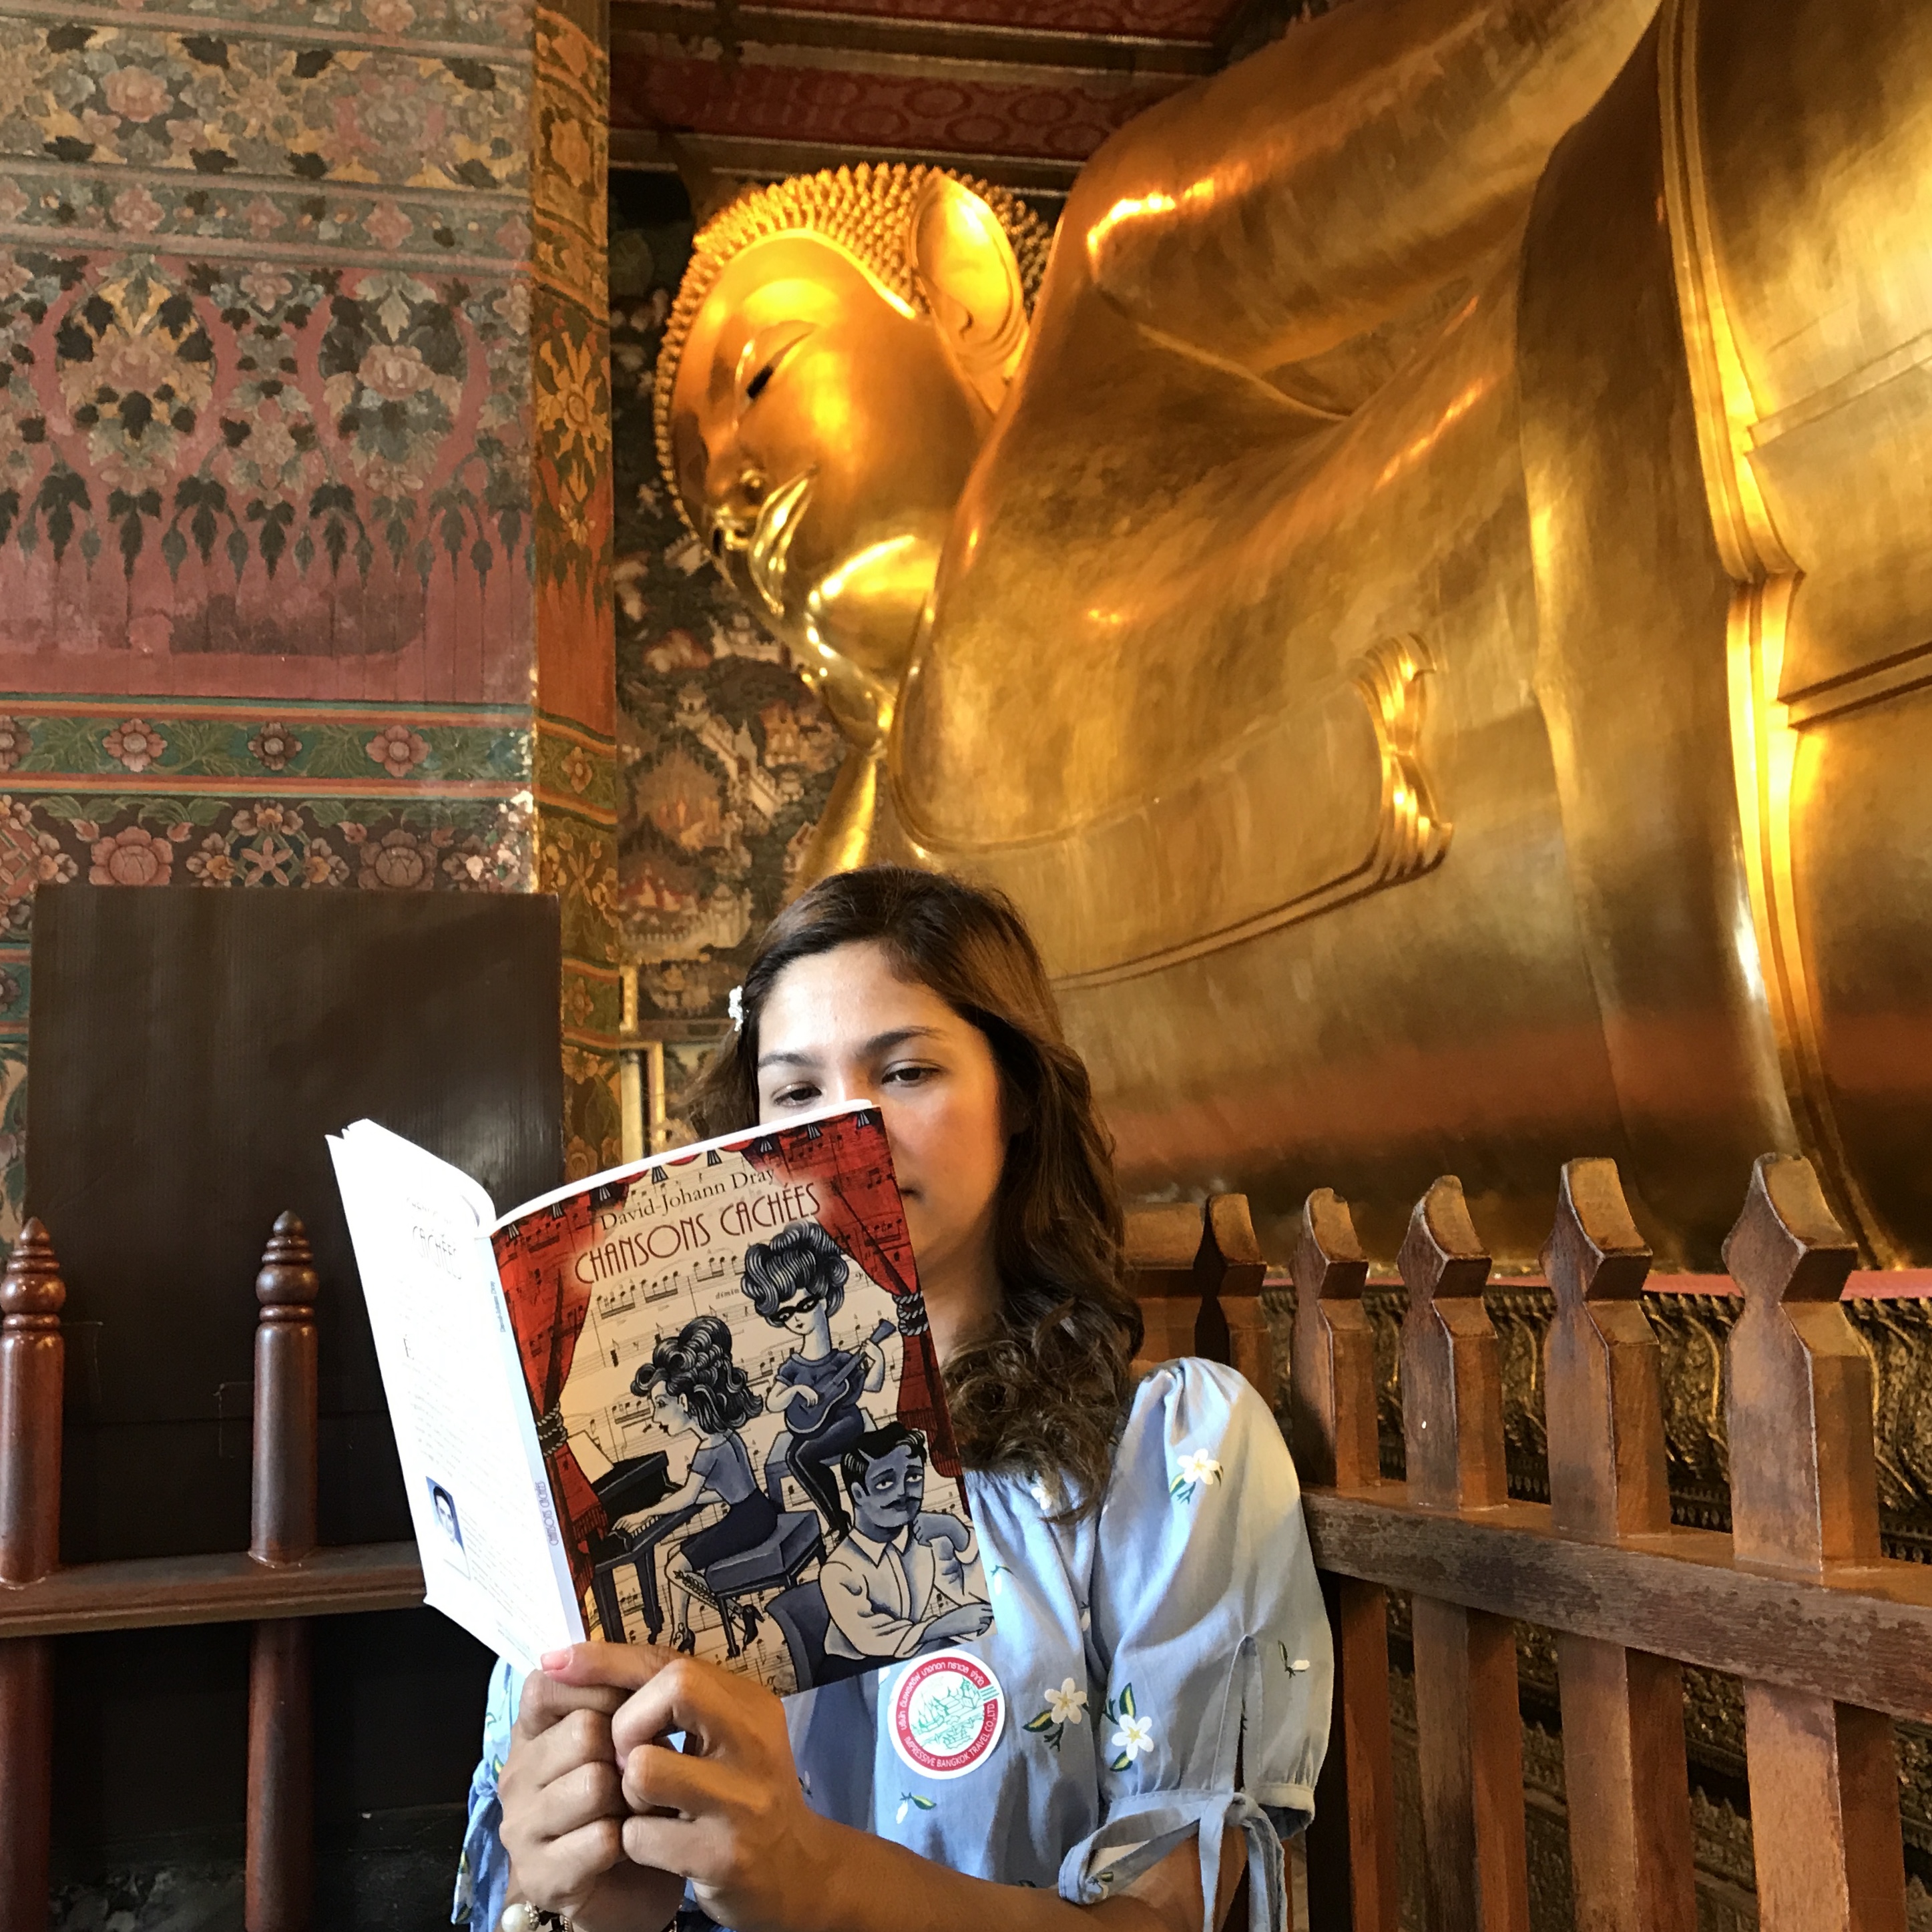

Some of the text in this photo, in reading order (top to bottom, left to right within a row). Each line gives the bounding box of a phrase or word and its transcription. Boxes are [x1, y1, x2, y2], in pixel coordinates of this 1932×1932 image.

[601, 1169, 774, 1230] David-Johann Dray
[575, 1182, 820, 1284] CHANSONS CACHÉES
[921, 1662, 945, 1676] บางกอก
[970, 1670, 984, 1686] จำกัด
[904, 1736, 936, 1766] IMPRESSIVE
[937, 1752, 971, 1767] BANGKOK
[968, 1733, 990, 1756] TRAVEL
